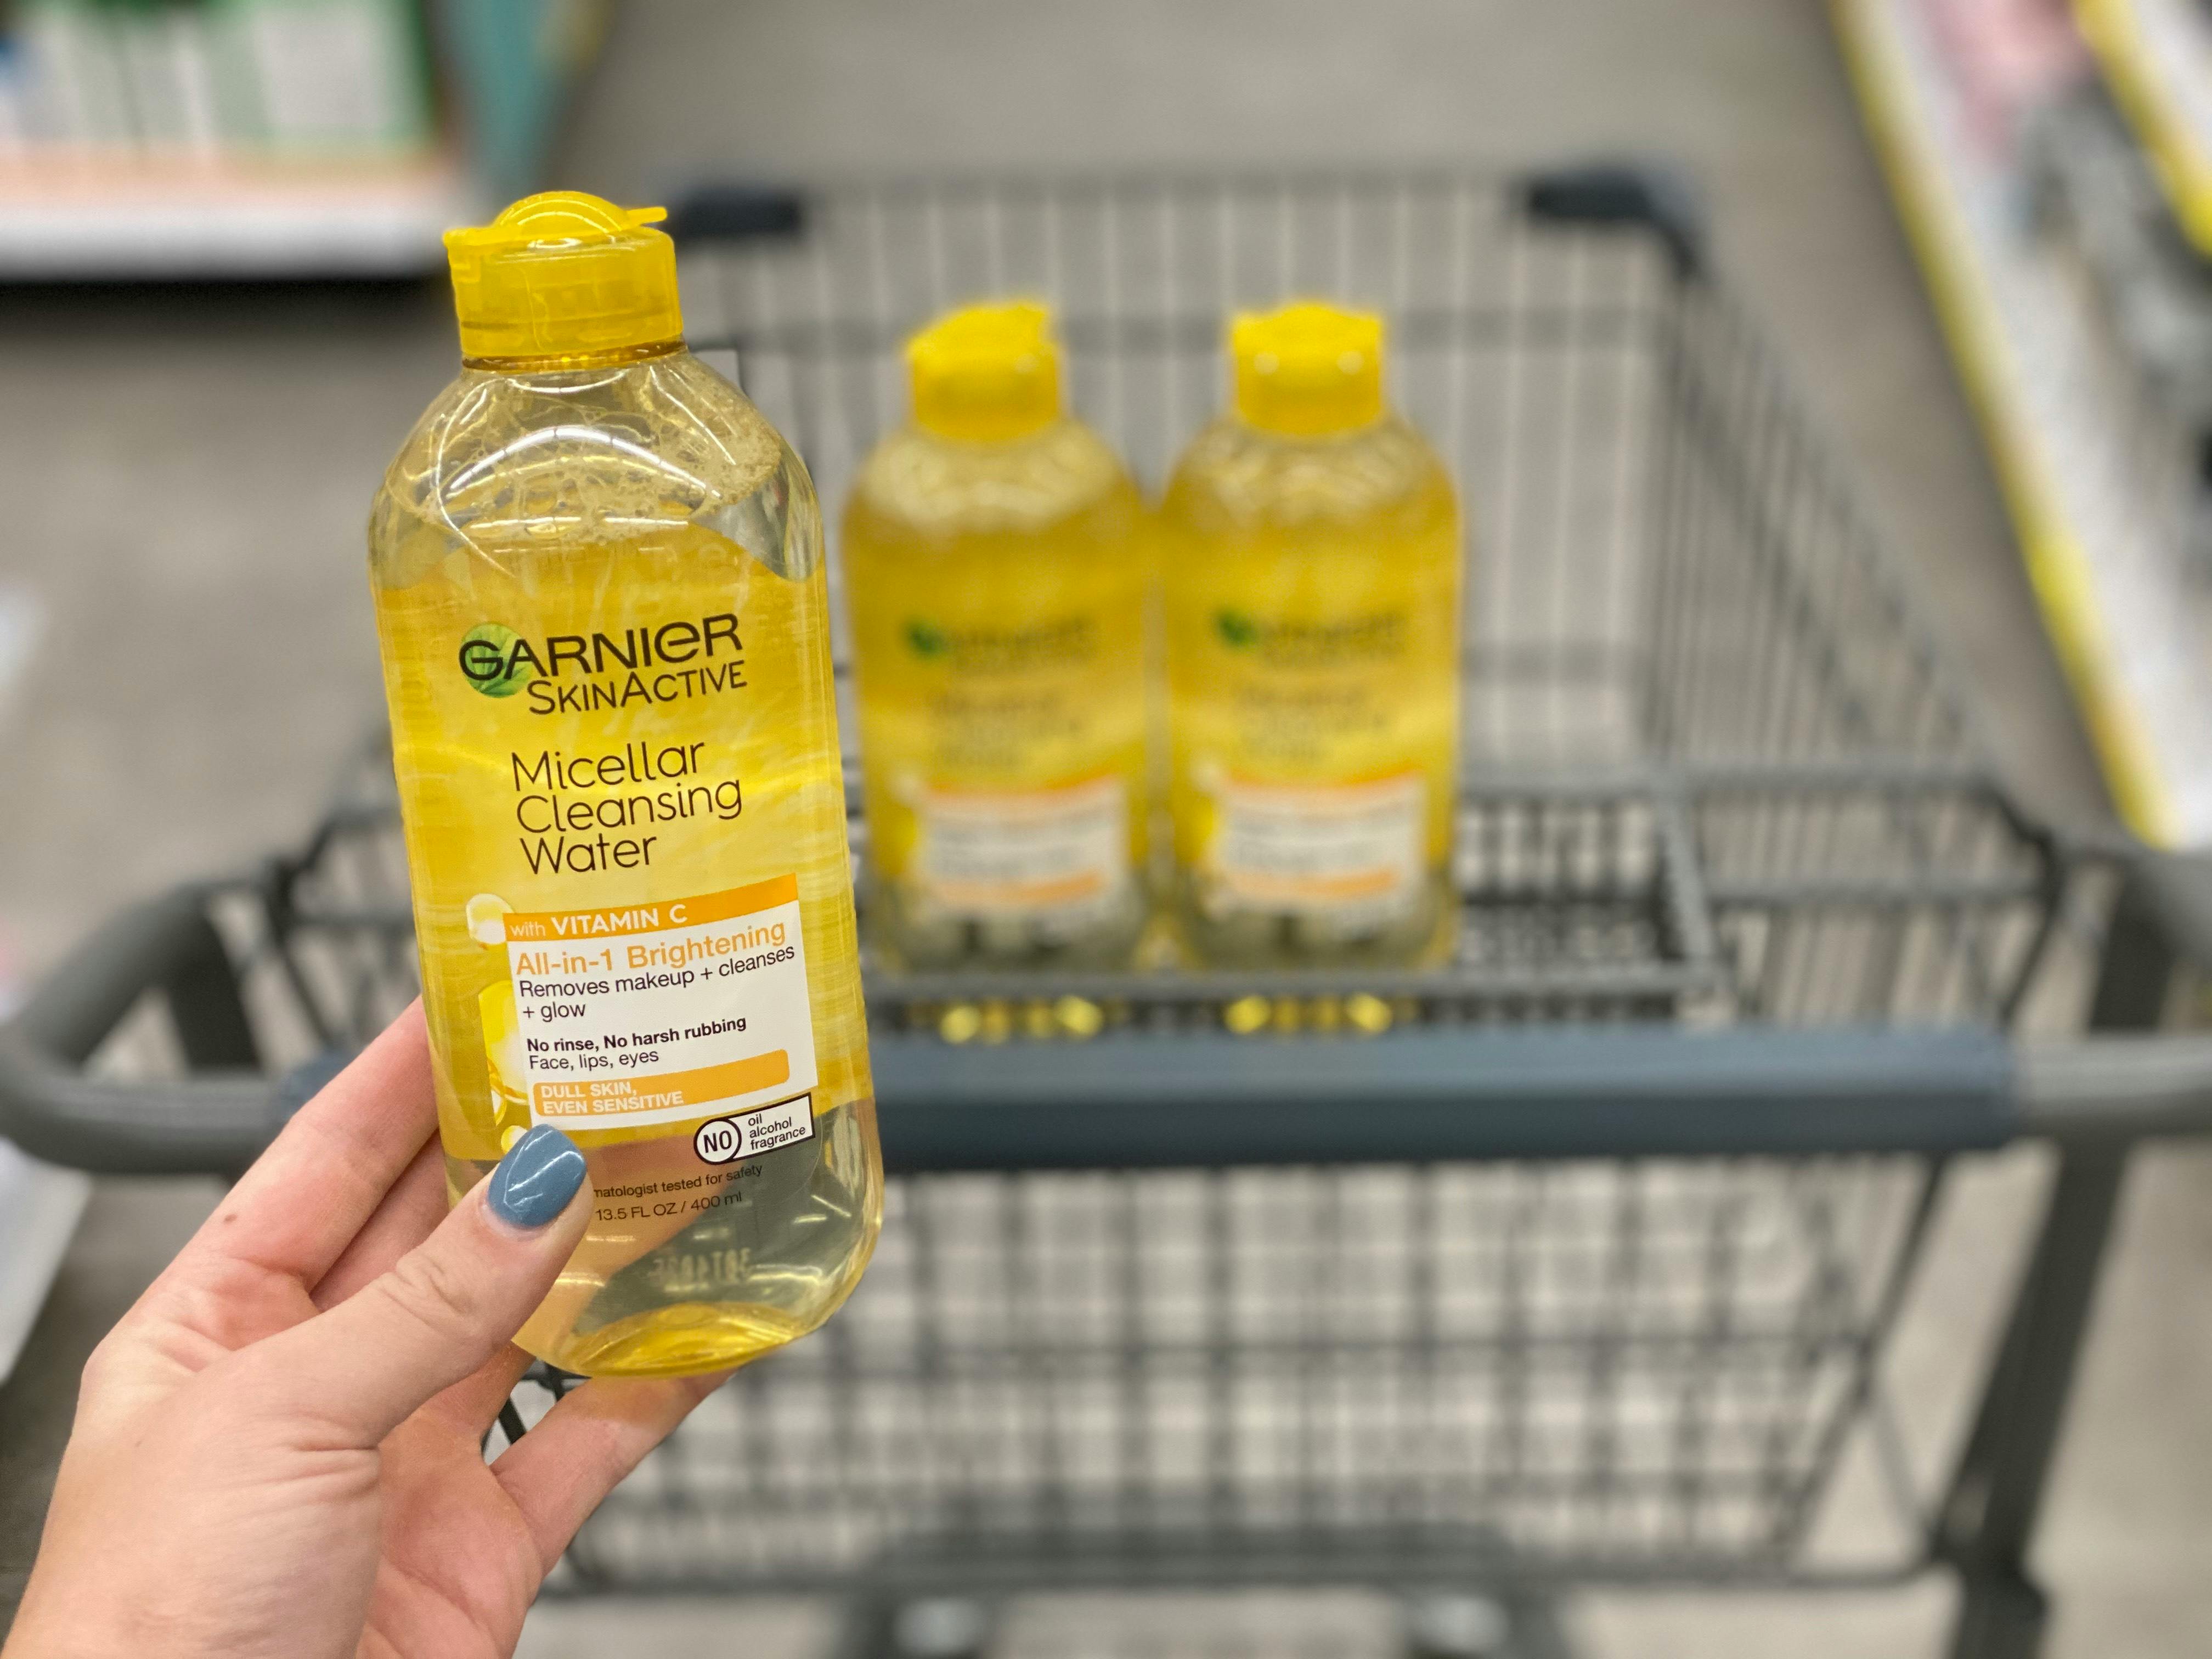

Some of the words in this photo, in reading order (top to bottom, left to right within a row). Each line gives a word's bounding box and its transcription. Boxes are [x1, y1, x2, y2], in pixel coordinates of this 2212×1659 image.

[459, 613, 743, 681] GARNIER
[527, 659, 748, 715] SKINACTIVE
[511, 741, 705, 792] Micellar
[516, 779, 742, 833] Cleansing
[520, 833, 657, 875] Water
[509, 921, 546, 938] with
[551, 907, 659, 936] VITAMIN
[669, 904, 688, 924] C
[516, 948, 613, 975] All-in-1
[627, 921, 786, 969] Brightening
[519, 979, 610, 998] Removes
[616, 969, 695, 992] makeup
[700, 968, 713, 980] +
[719, 945, 795, 977] cleanses
[523, 1006, 535, 1019] +
[541, 1001, 586, 1023] glow
[527, 1038, 550, 1052] No
[554, 1035, 600, 1052] rinse,
[604, 1034, 628, 1049] No
[632, 1028, 680, 1047] harsh
[685, 1015, 747, 1040] rubbing
[529, 1054, 574, 1071] Face,
[579, 1053, 614, 1072] lips,
[619, 1049, 659, 1067] eyes
[540, 1085, 586, 1098] DULL
[589, 1081, 637, 1097] SKIN,
[543, 1101, 588, 1114] EVEN
[592, 1090, 684, 1113] SENSITIVE
[748, 1113, 763, 1126] oil
[749, 1116, 792, 1138] alcohol
[703, 1130, 732, 1154] NO
[750, 1126, 806, 1150] fragrance
[593, 1182, 658, 1198] matologist
[662, 1176, 702, 1192] tested
[705, 1173, 723, 1186] for
[726, 1165, 763, 1182] safety
[595, 1208, 627, 1221] 13.5
[630, 1206, 651, 1218] FL
[653, 1202, 678, 1216] OZ
[680, 1200, 687, 1213] /
[690, 1195, 720, 1211] 400
[724, 1191, 742, 1205] ml
